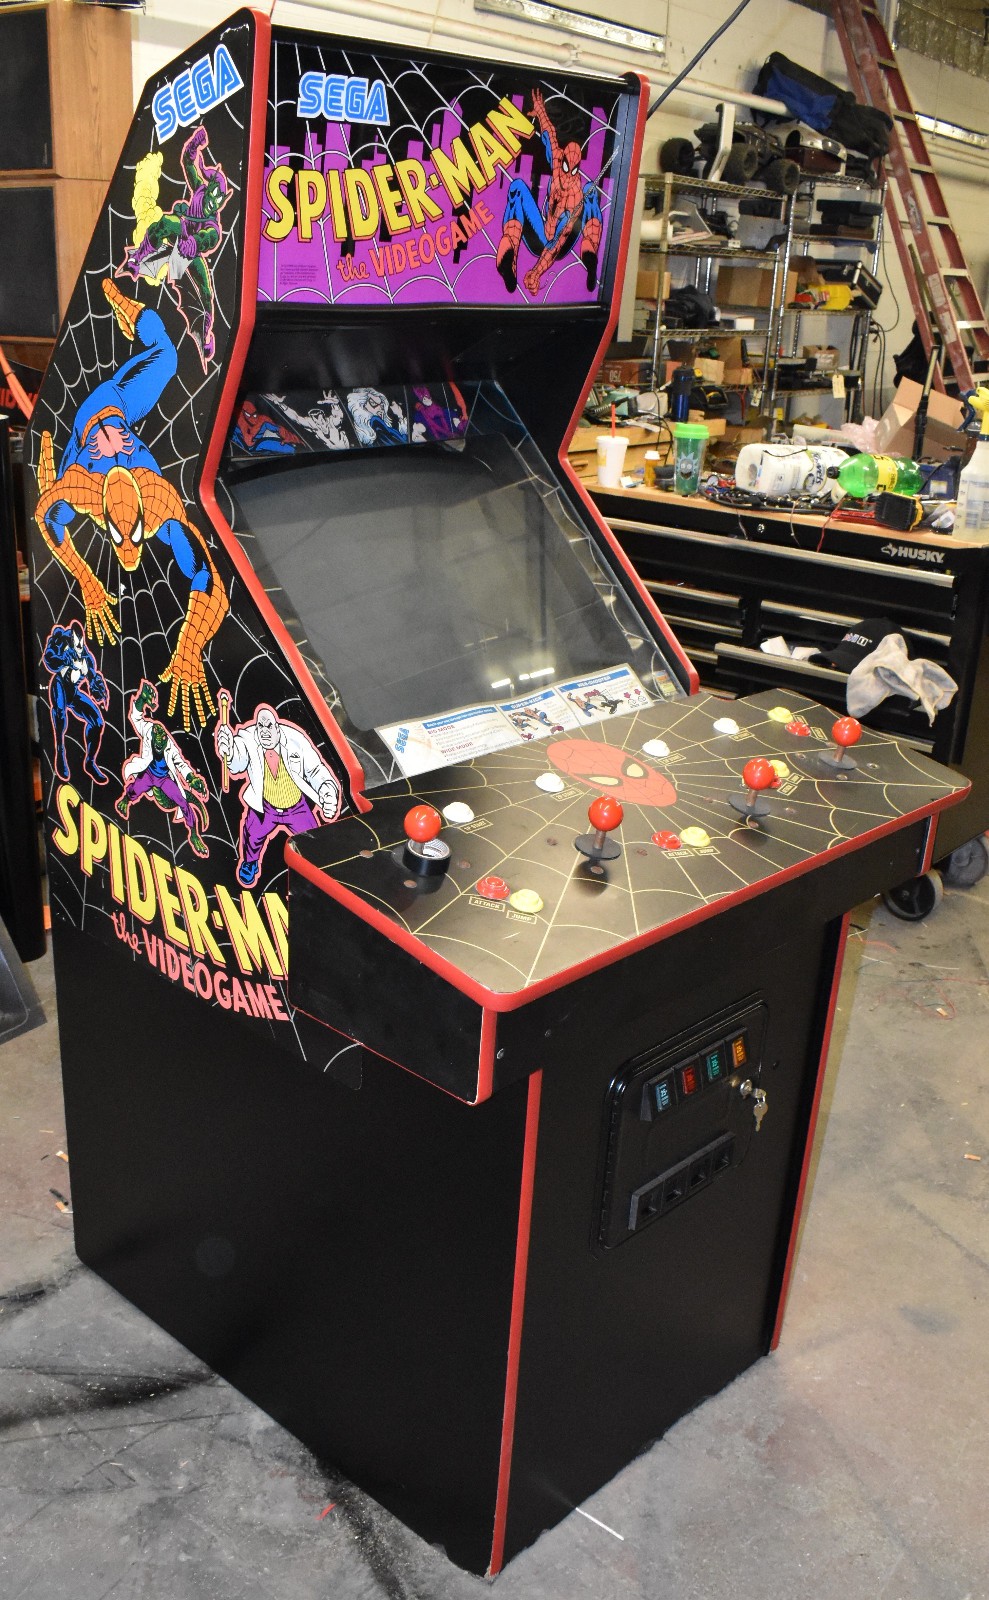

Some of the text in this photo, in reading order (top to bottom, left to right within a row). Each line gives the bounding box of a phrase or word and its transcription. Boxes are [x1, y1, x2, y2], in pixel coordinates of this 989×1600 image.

[152, 44, 244, 145] SEGA
[297, 71, 390, 126] SEGA
[262, 97, 535, 242] SPIDER-MAN
[337, 254, 370, 281] the
[369, 200, 495, 277] VIDEOGAME
[898, 546, 945, 563] HUSKY
[52, 785, 289, 980] SPIDER-MA
[474, 899, 500, 909] ATTACK
[512, 913, 532, 921] JUMP
[111, 912, 291, 1021] the VIDEOGAME
